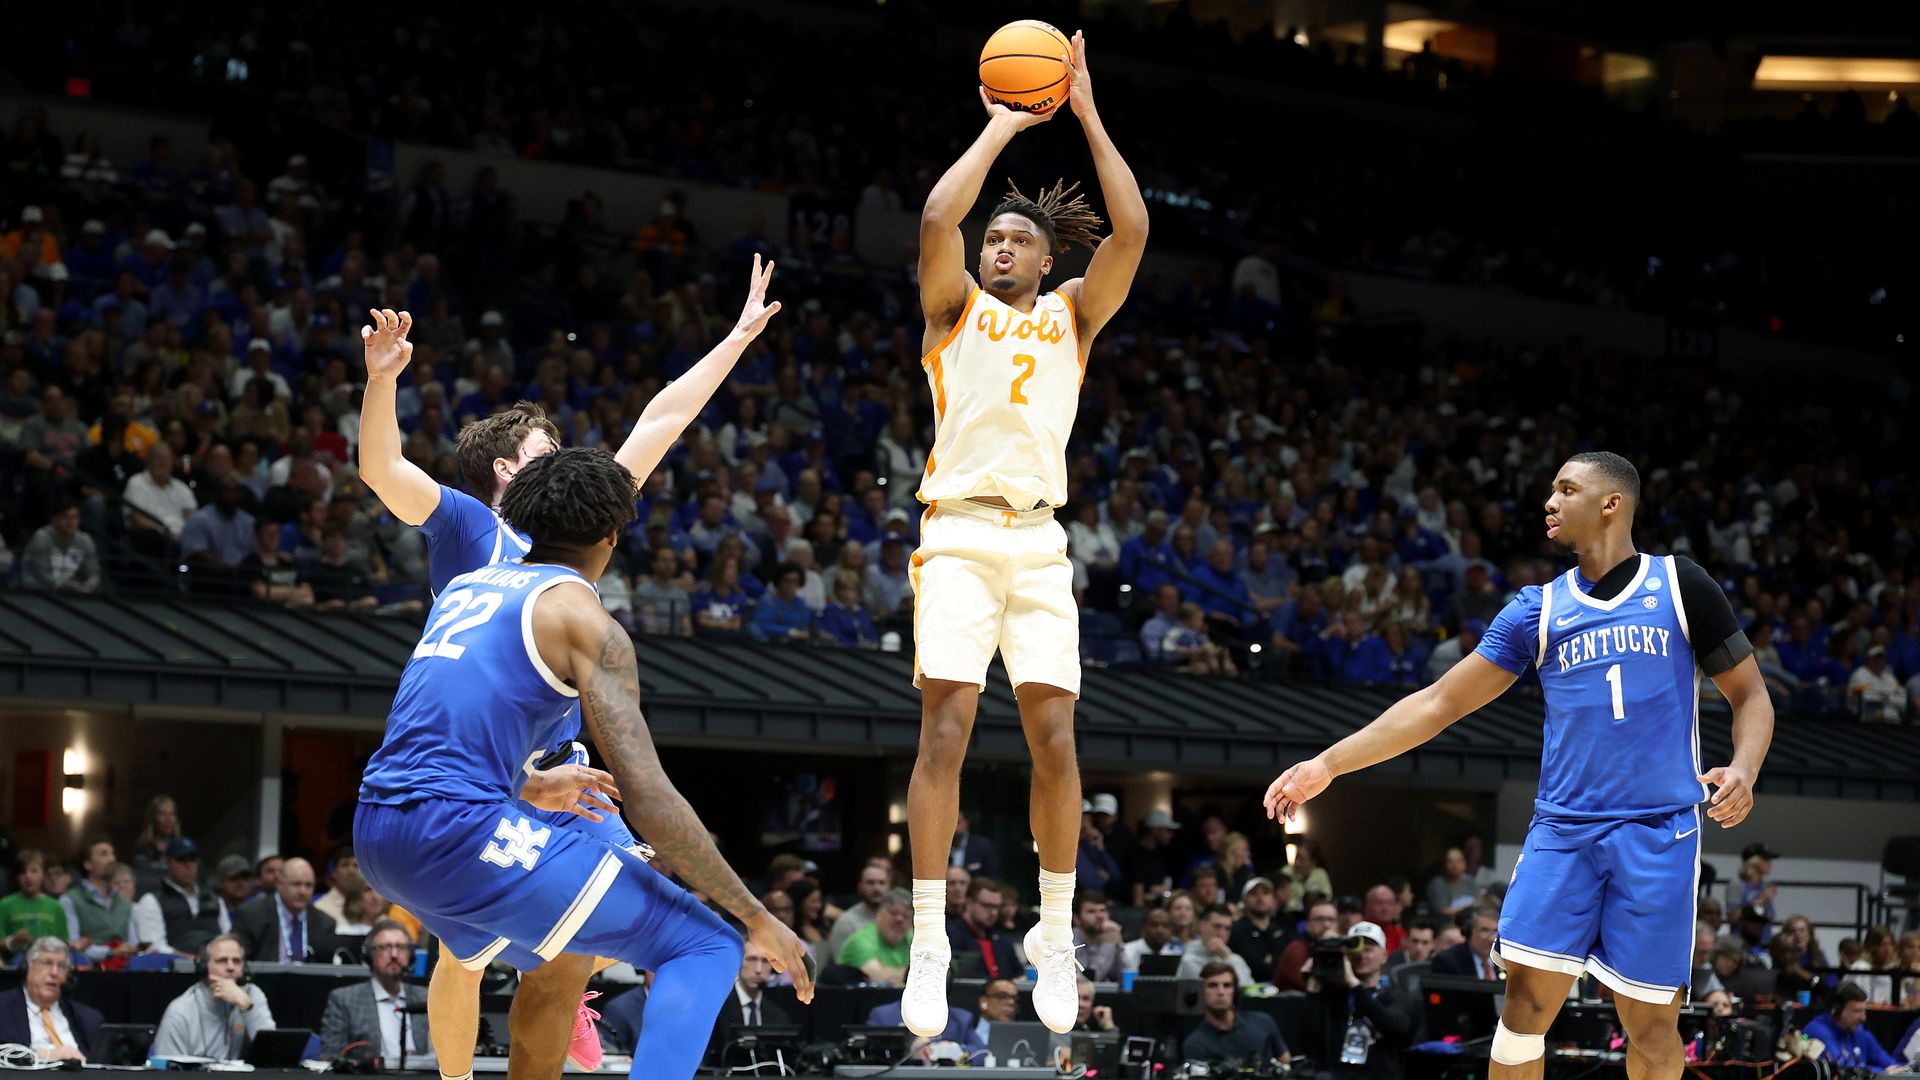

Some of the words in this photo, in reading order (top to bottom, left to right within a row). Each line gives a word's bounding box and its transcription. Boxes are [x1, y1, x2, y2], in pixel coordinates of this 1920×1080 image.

[978, 309, 1066, 344] Vols
[1010, 353, 1036, 405] 2
[1002, 511, 1018, 528] T
[413, 589, 503, 660] 22
[1558, 625, 1670, 673] KENTUCKY
[1605, 663, 1625, 720] 1
